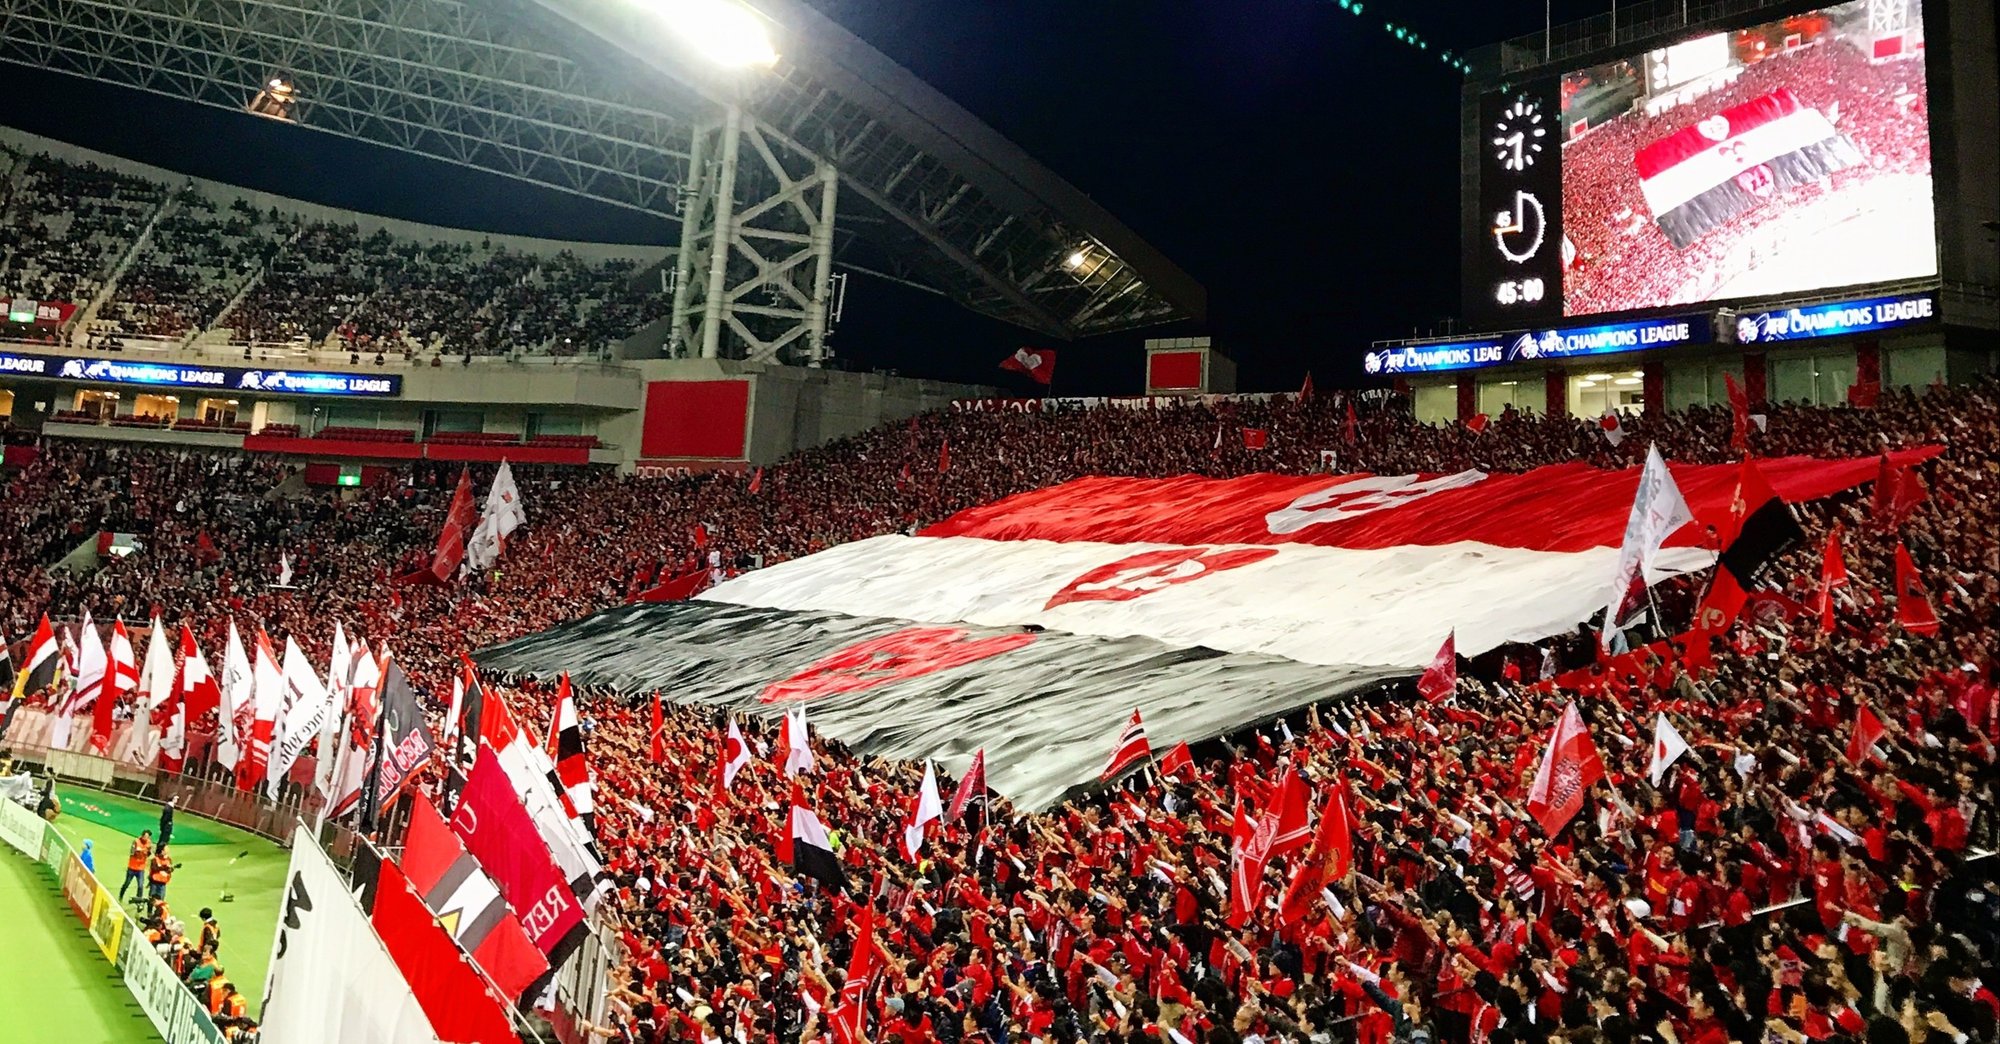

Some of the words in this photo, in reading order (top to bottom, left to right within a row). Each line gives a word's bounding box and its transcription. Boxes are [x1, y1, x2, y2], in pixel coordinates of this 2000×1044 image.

[1497, 279, 1544, 303] 45:00
[1791, 307, 1873, 332] CHAMPIONS
[1876, 299, 1933, 323] LEAGUE
[1567, 330, 1637, 351] CHAMPIONS
[1640, 324, 1690, 344] LEAGUE
[0, 359, 45, 373] LEAGUE
[1407, 349, 1470, 368] CHAMPIONS
[1474, 346, 1503, 362] LEAG
[109, 365, 178, 382] CHAMPIONS
[180, 370, 225, 385] LEAGUE
[285, 375, 347, 391] CHAMPIONS
[350, 379, 391, 393] LEAGUE
